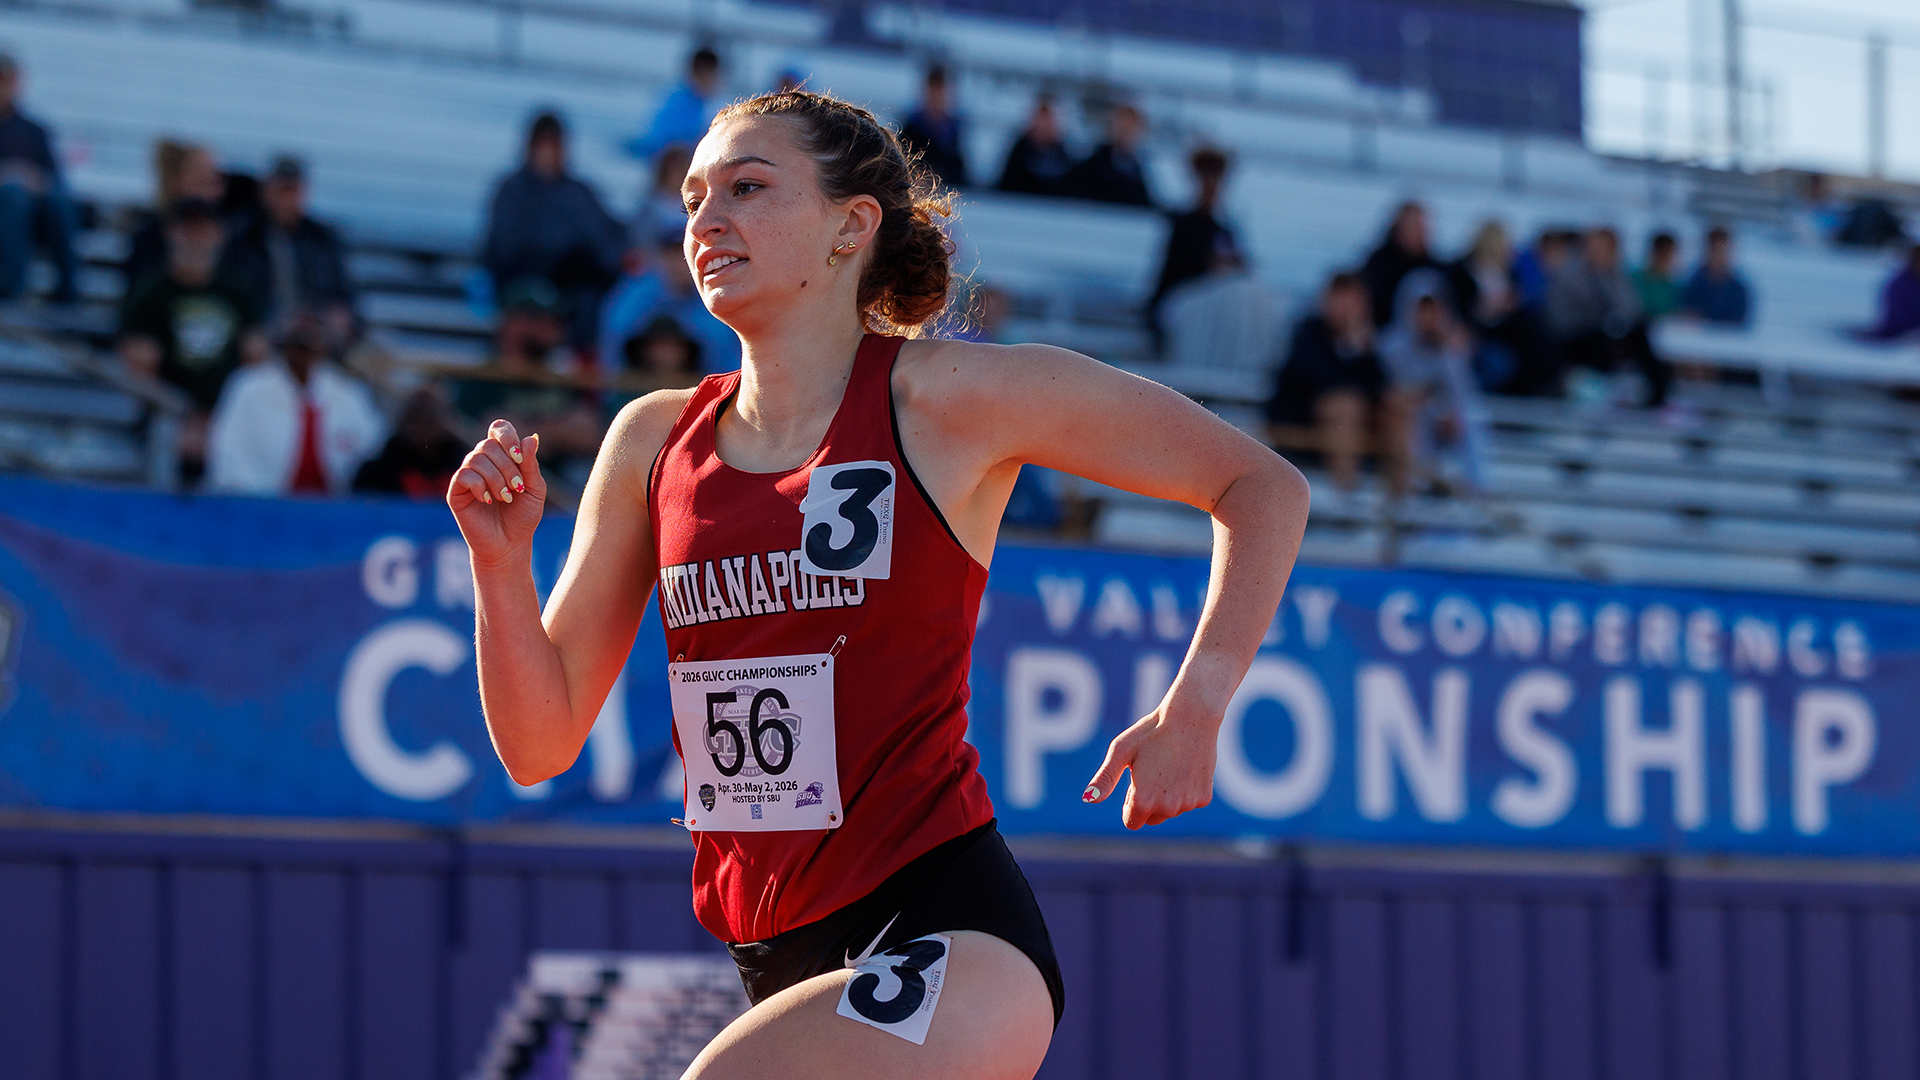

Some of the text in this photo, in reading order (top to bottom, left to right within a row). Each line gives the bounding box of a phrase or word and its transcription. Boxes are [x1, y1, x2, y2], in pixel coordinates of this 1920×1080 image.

[805, 468, 893, 572] 3
[882, 521, 890, 545] TIMING
[1037, 571, 1872, 680] VALY CONFERENCE
[681, 665, 818, 683] 2026 GLVC CHAMPIONSHIPS
[338, 616, 1878, 836] CPONSHIP
[706, 688, 794, 777] 56
[717, 782, 732, 795] Apr.
[732, 782, 763, 795] 30-May
[764, 781, 774, 794] 2,
[774, 781, 798, 792] 2026
[732, 794, 781, 804] HOSTED BY SBU
[848, 939, 946, 1024] 3
